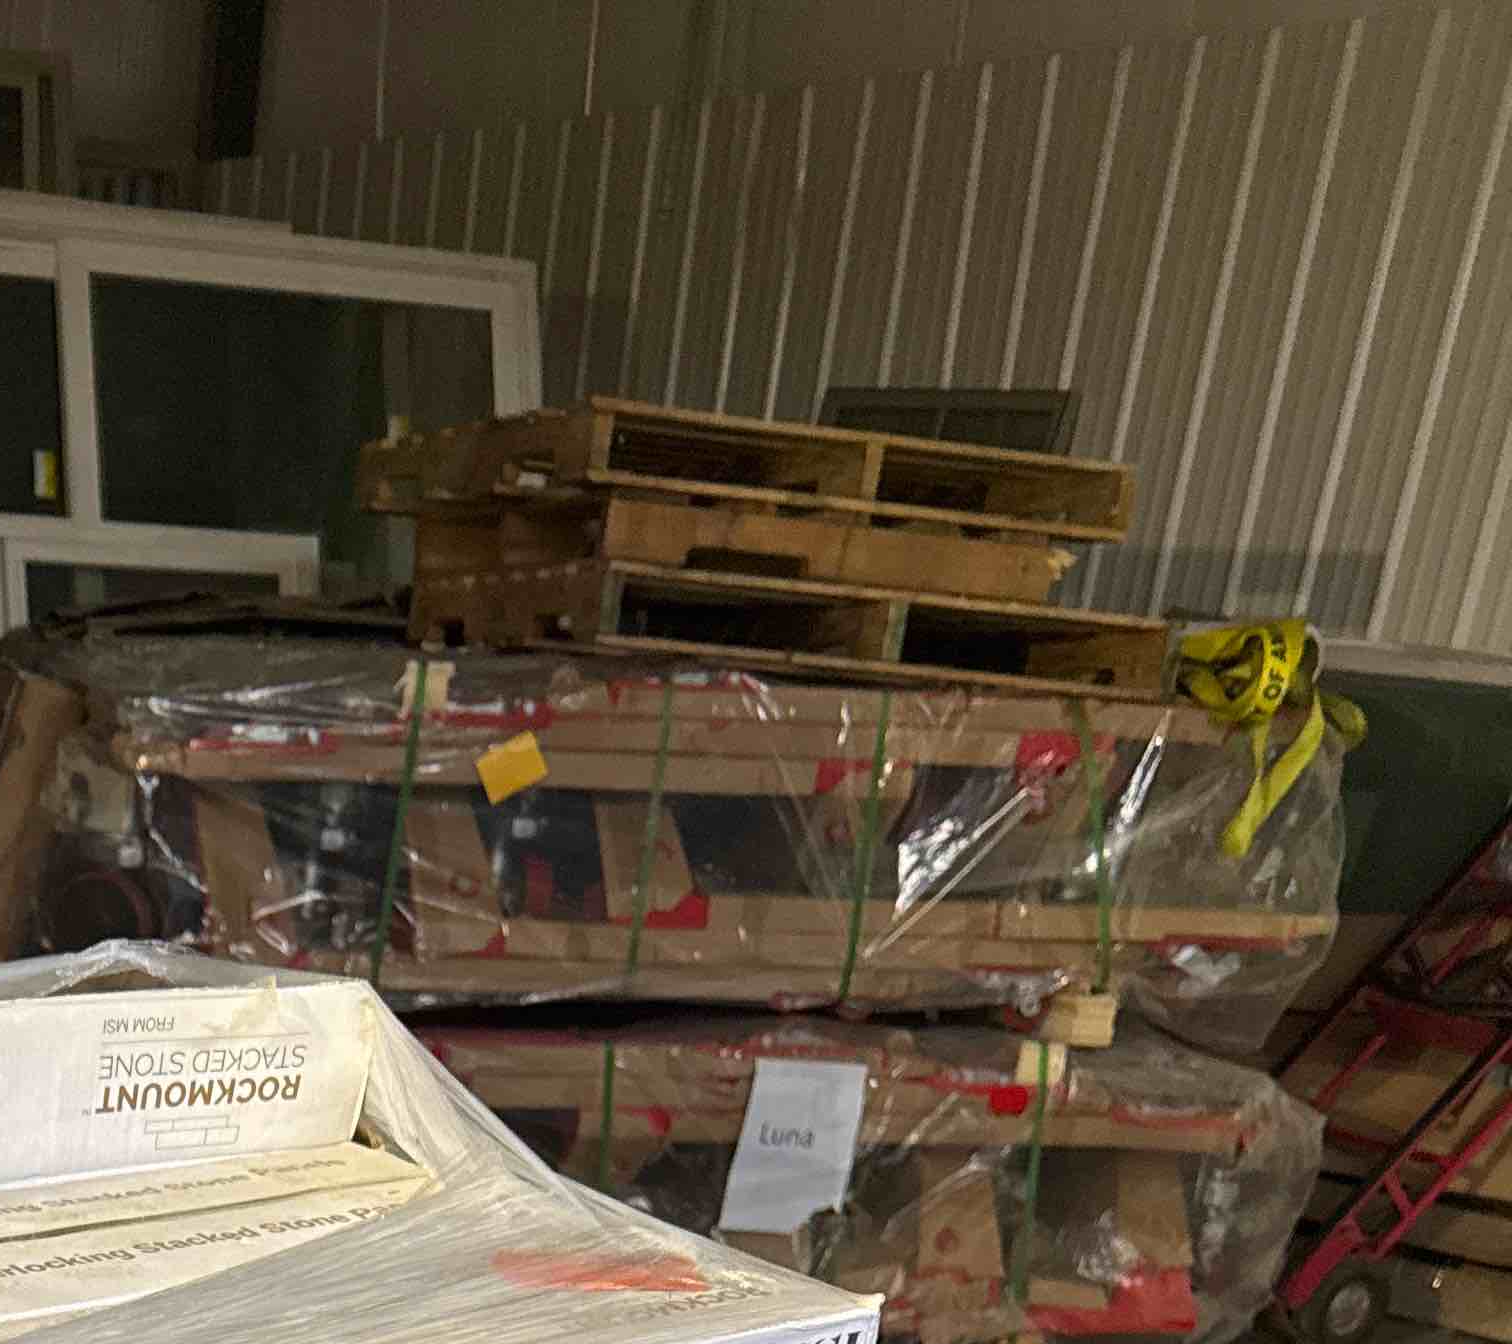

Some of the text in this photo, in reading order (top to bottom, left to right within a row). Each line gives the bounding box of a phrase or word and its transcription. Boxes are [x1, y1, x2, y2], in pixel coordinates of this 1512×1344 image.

[102, 1014, 176, 1035] FROM MSI
[99, 1044, 308, 1081] STACKED STONE
[95, 1074, 302, 1115] ROCKMOUNT
[757, 1121, 816, 1151] Luna
[132, 1224, 256, 1258] Stacked
[261, 1208, 348, 1236] Stone
